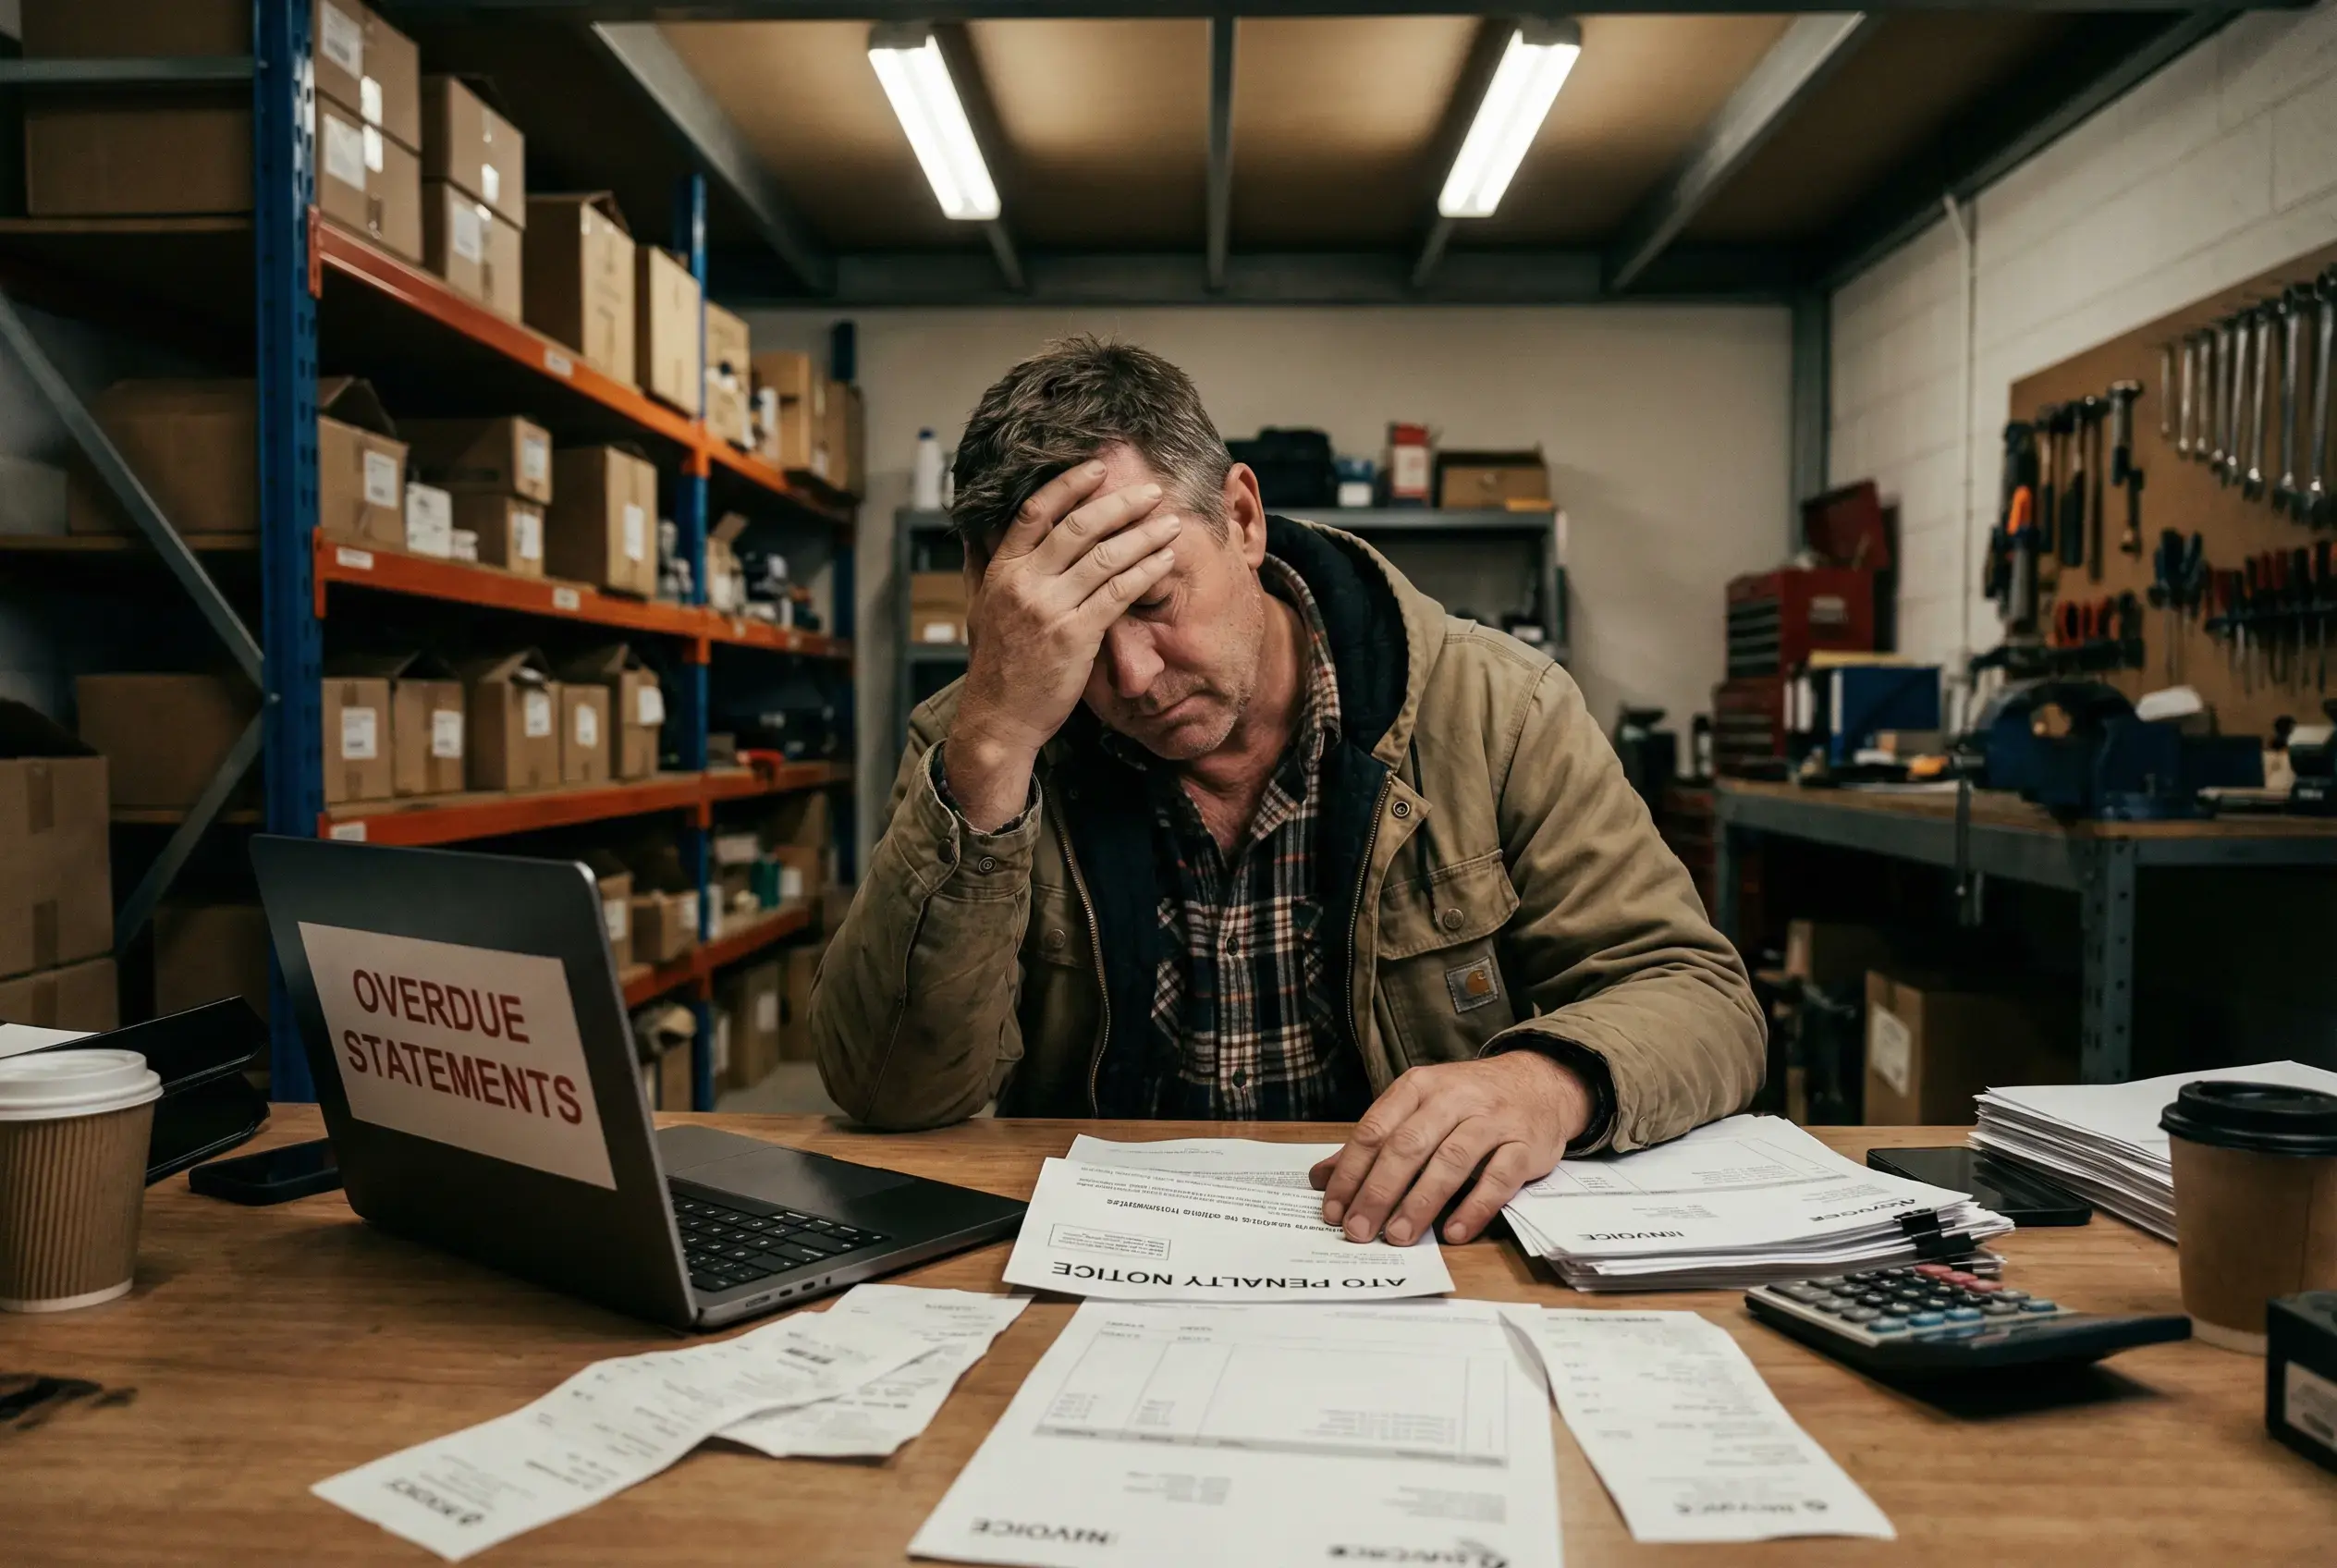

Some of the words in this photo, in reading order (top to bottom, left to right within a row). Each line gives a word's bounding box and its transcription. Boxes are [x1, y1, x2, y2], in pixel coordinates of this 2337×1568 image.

[353, 969, 531, 1045] OVERDUE
[343, 1029, 583, 1125] STATEMENTS
[1051, 1261, 1173, 1286] NOTICE
[1183, 1275, 1330, 1290] PENALTY
[1341, 1277, 1407, 1289] ATO
